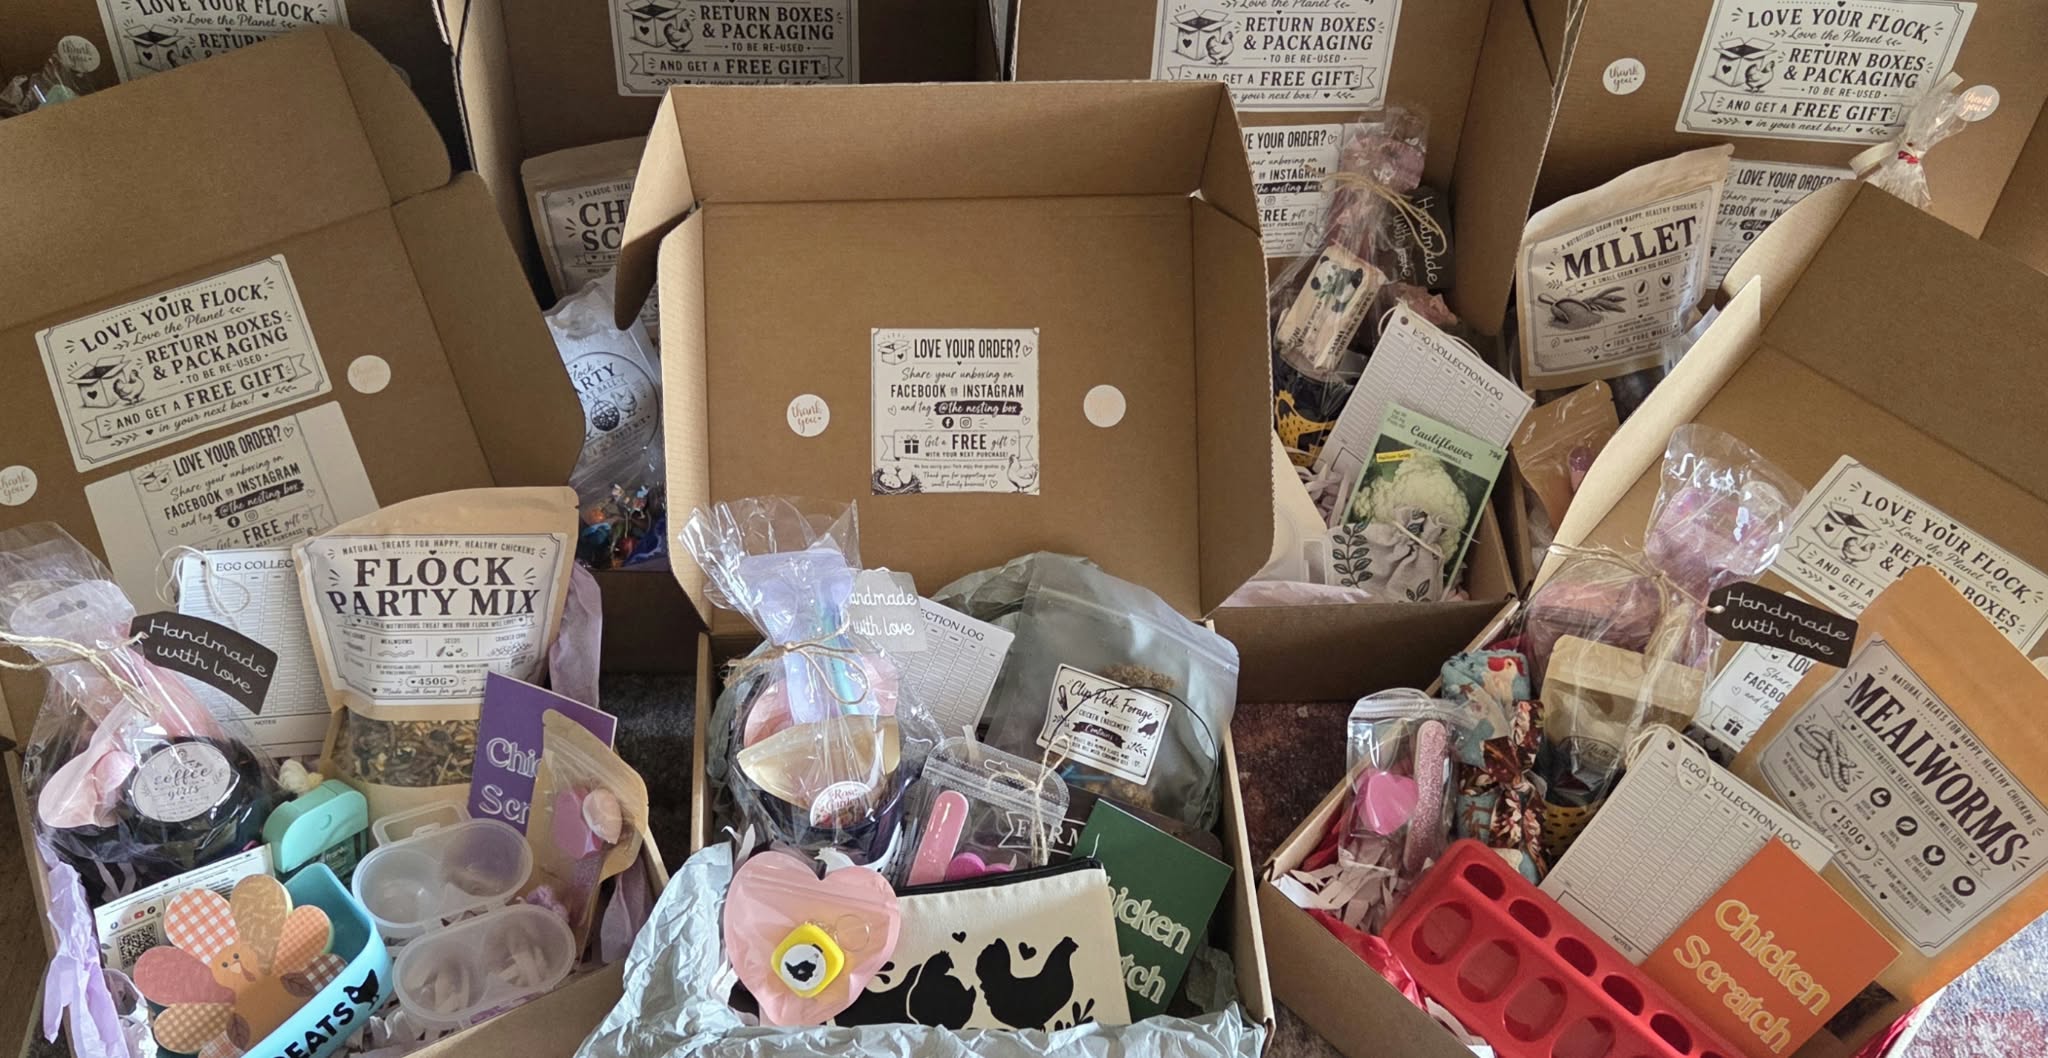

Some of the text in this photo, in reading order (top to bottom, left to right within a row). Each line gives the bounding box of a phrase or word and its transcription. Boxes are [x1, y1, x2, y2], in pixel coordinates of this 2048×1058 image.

[217, 14, 276, 27] the Planet
[701, 5, 834, 22] RETURN BOXES
[1245, 17, 1377, 32] RETURN BOXES
[1747, 8, 1931, 44] LOVE YOUR FLOCK,
[702, 23, 834, 41] & PACKAGING
[1243, 35, 1373, 50] & PACKAGING
[1787, 28, 1883, 45] Love the Planet
[732, 42, 804, 52] TO RE-USED
[1270, 55, 1341, 63] TO BE RE-USED
[1788, 47, 1925, 71] RETURN BOXES
[660, 60, 821, 75] AND GET FREE GIFT
[1260, 71, 1354, 87] FREE GIFT
[1784, 66, 1918, 88] & PACKAGING
[1268, 91, 1291, 100] next
[1727, 99, 1893, 123] AND GET FREE GIFT
[1258, 130, 1326, 149] YOUR ORDER?
[1768, 121, 1822, 133] your next
[1737, 169, 1797, 189] LOVE YOUR
[1562, 216, 1697, 282] MILLET
[79, 283, 268, 353] LOVE YOUR FLOCK,
[132, 308, 225, 347] Love the Planet
[144, 309, 282, 364] RETURN BOXES
[914, 339, 1021, 358] LOVE YOUR ORDER?
[152, 325, 289, 381] & PACKAGING
[186, 353, 262, 383] TO BE RE-USED
[902, 367, 1000, 383] Share your unboxing
[1431, 342, 1505, 401] COLLECTION LOG
[116, 363, 285, 430] AND GET A FREE GIFT
[891, 384, 1024, 398] FACEBOOK INSTAGRAM
[174, 403, 228, 431] your next
[901, 402, 999, 418] and nesting
[172, 424, 282, 478] LOVE YOUR ORDER?
[952, 434, 1008, 449] FREE gift
[1410, 425, 1474, 460] Cauliflower
[163, 462, 301, 520] FACEBOOK INSTAGRAM
[243, 519, 282, 544] FREE
[343, 540, 535, 555] NATURAL TREATS FOR HAPPY, HEALTHY CHICKENS
[1861, 490, 2032, 605] LOVE YOUR FLOCK,
[1895, 526, 1983, 581] Love the Planet
[216, 561, 241, 572] EGG
[353, 557, 515, 587] FLOCK
[1816, 557, 1866, 591] AND GET
[326, 589, 541, 616] PARTY MIX
[1725, 590, 1850, 642] Handmade
[852, 616, 915, 636] with love
[961, 625, 984, 641] LOG
[1731, 617, 1835, 656] with love
[150, 619, 268, 678] Handmade
[156, 645, 252, 694] with love
[1070, 680, 1092, 699] Clip
[1122, 698, 1153, 723] Forage
[1079, 709, 1098, 721] CHICKEN
[1891, 674, 2038, 826] NATURAL TREATS FOR HAPPY, HEALTHY CHICKENS
[1843, 673, 2030, 866] MEALWORMS
[1861, 736, 1897, 777] HIGH-PROTEIN
[1896, 773, 1916, 793] TREAT
[1913, 790, 1930, 806] YOUR
[1924, 802, 1941, 821] FLOCK
[1939, 818, 1954, 834] WILL
[1681, 756, 1801, 851] EGG COLLECTION LOG
[1836, 815, 1866, 845] 150G
[1611, 934, 1633, 954] NOTES
[1714, 898, 1832, 1016] Chicken
[1673, 934, 1792, 1054] Scratch
